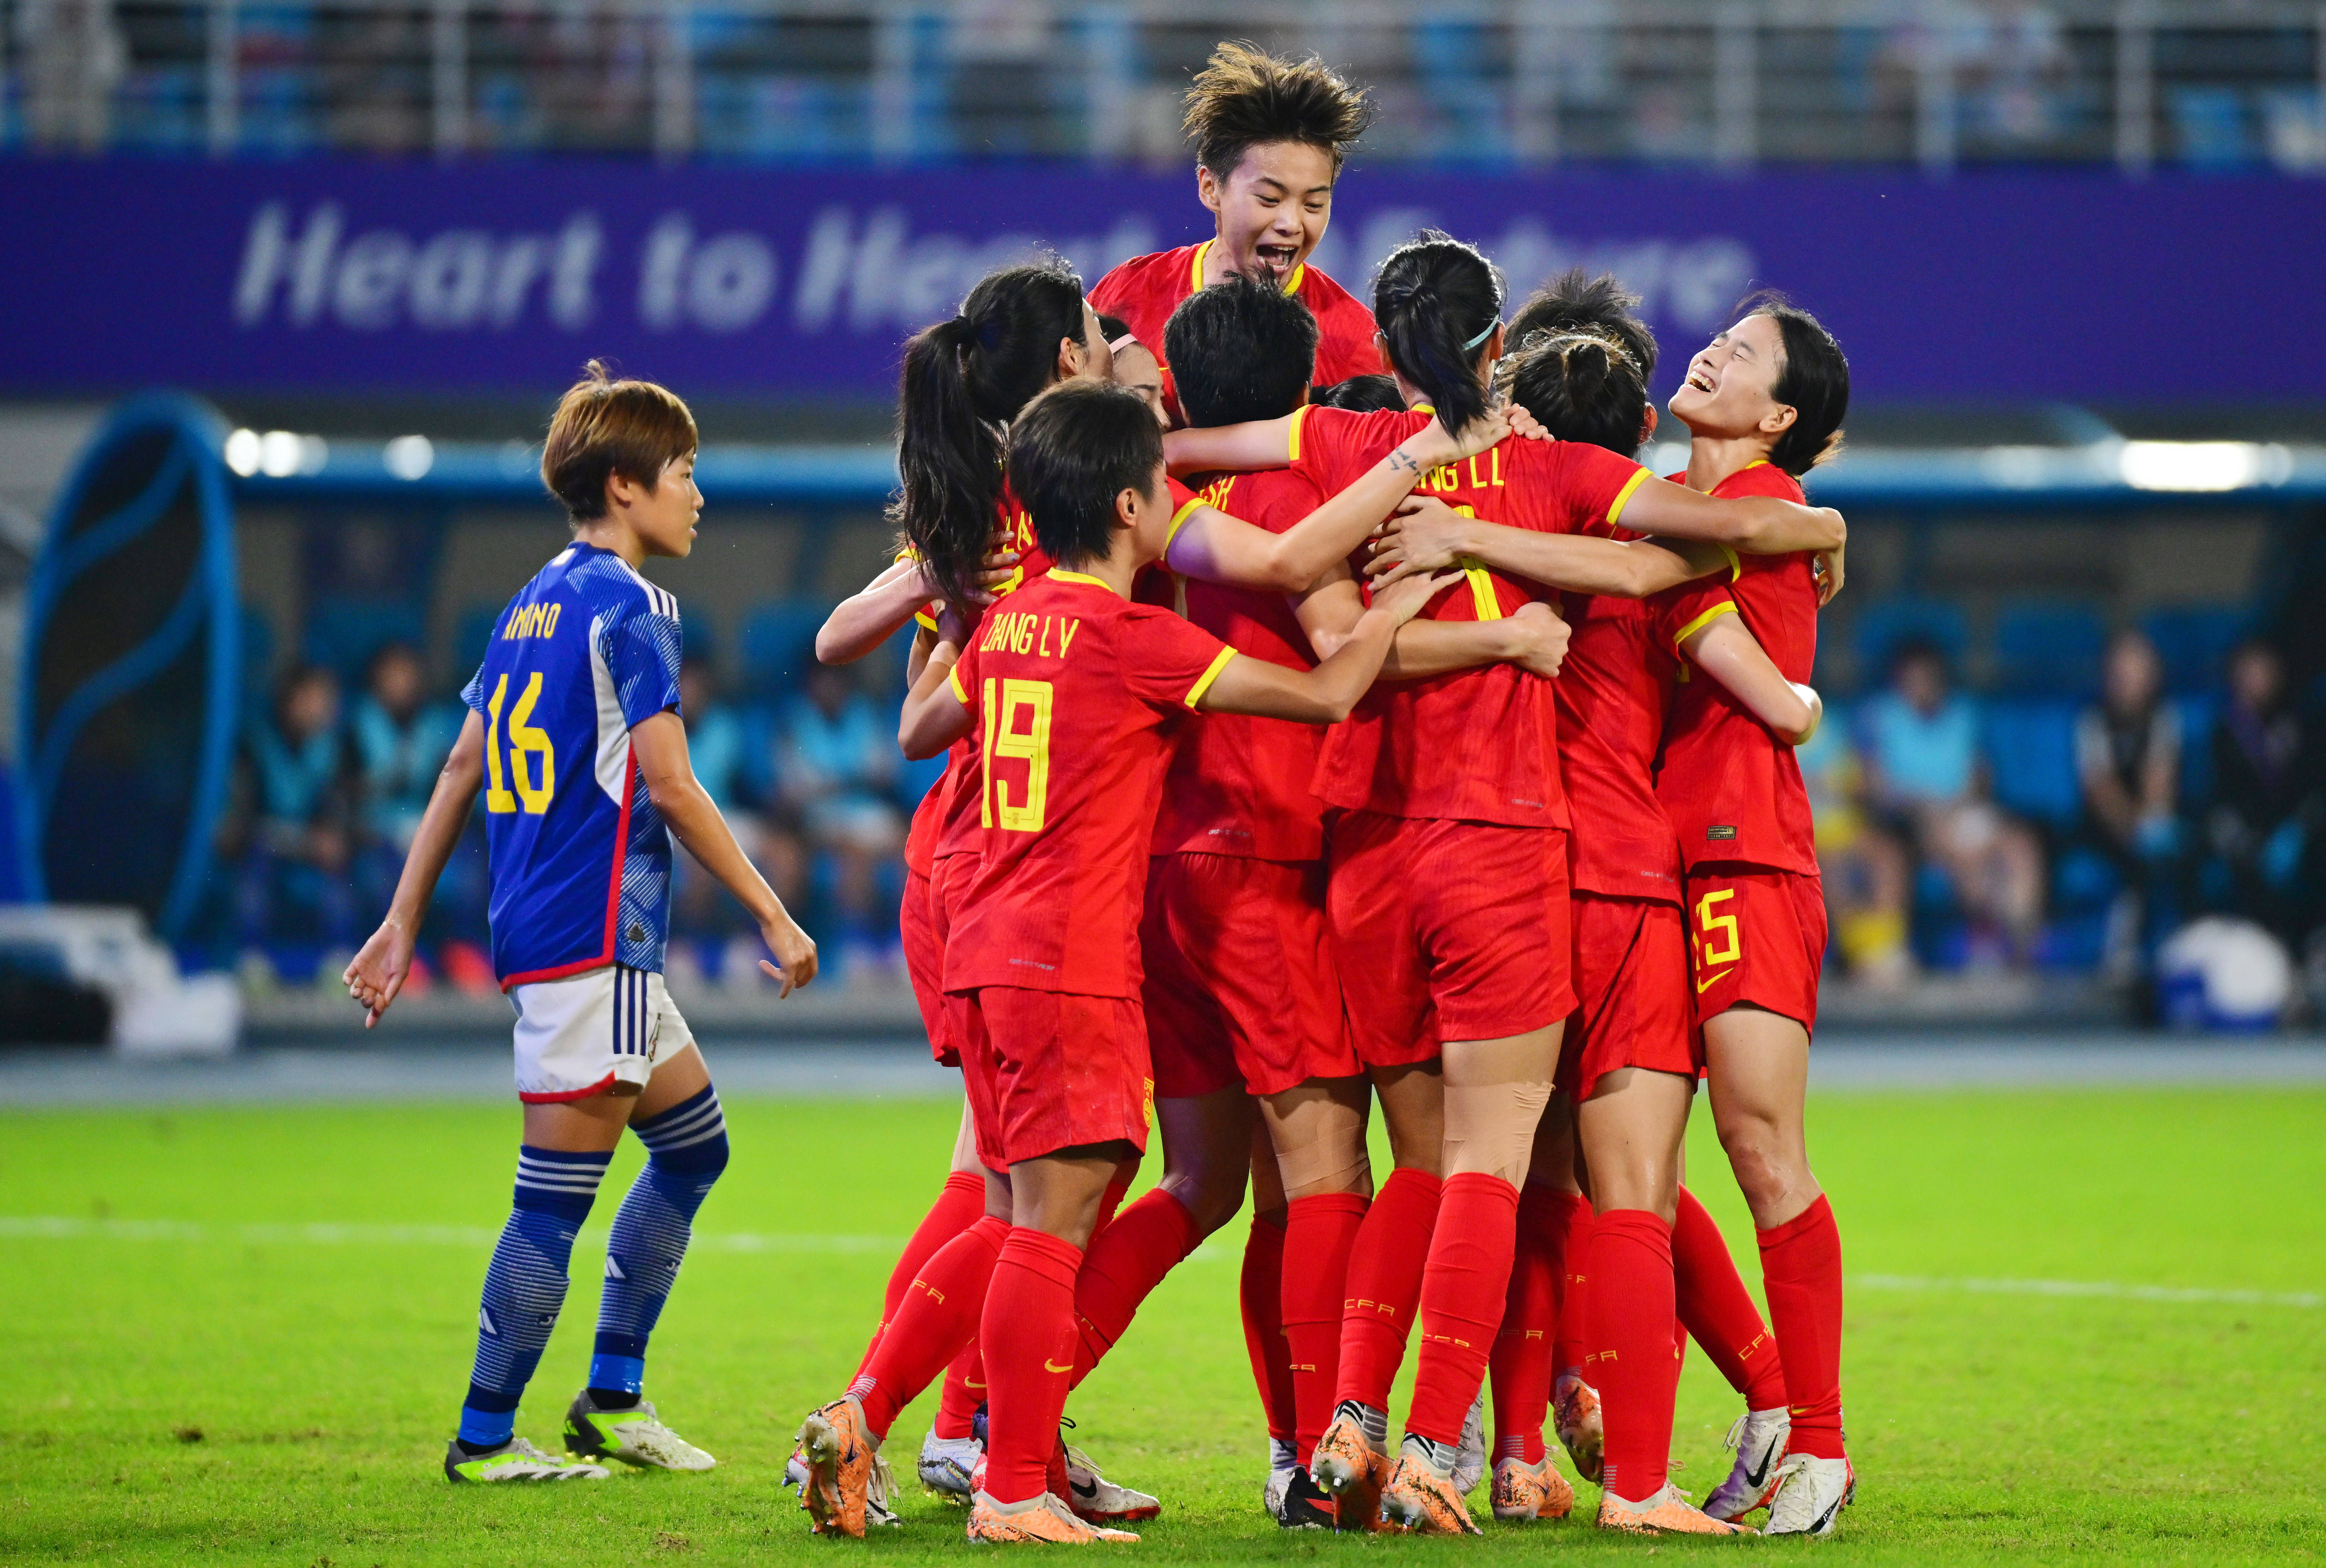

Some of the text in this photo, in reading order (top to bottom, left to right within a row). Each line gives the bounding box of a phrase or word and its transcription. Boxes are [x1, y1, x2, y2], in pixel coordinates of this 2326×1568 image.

[233, 200, 605, 331] Heart
[640, 209, 778, 331] to
[979, 612, 1080, 658] ZHANG LY
[486, 671, 555, 815] 16
[981, 677, 1053, 832] 19
[1345, 1299, 1395, 1316] CFA
